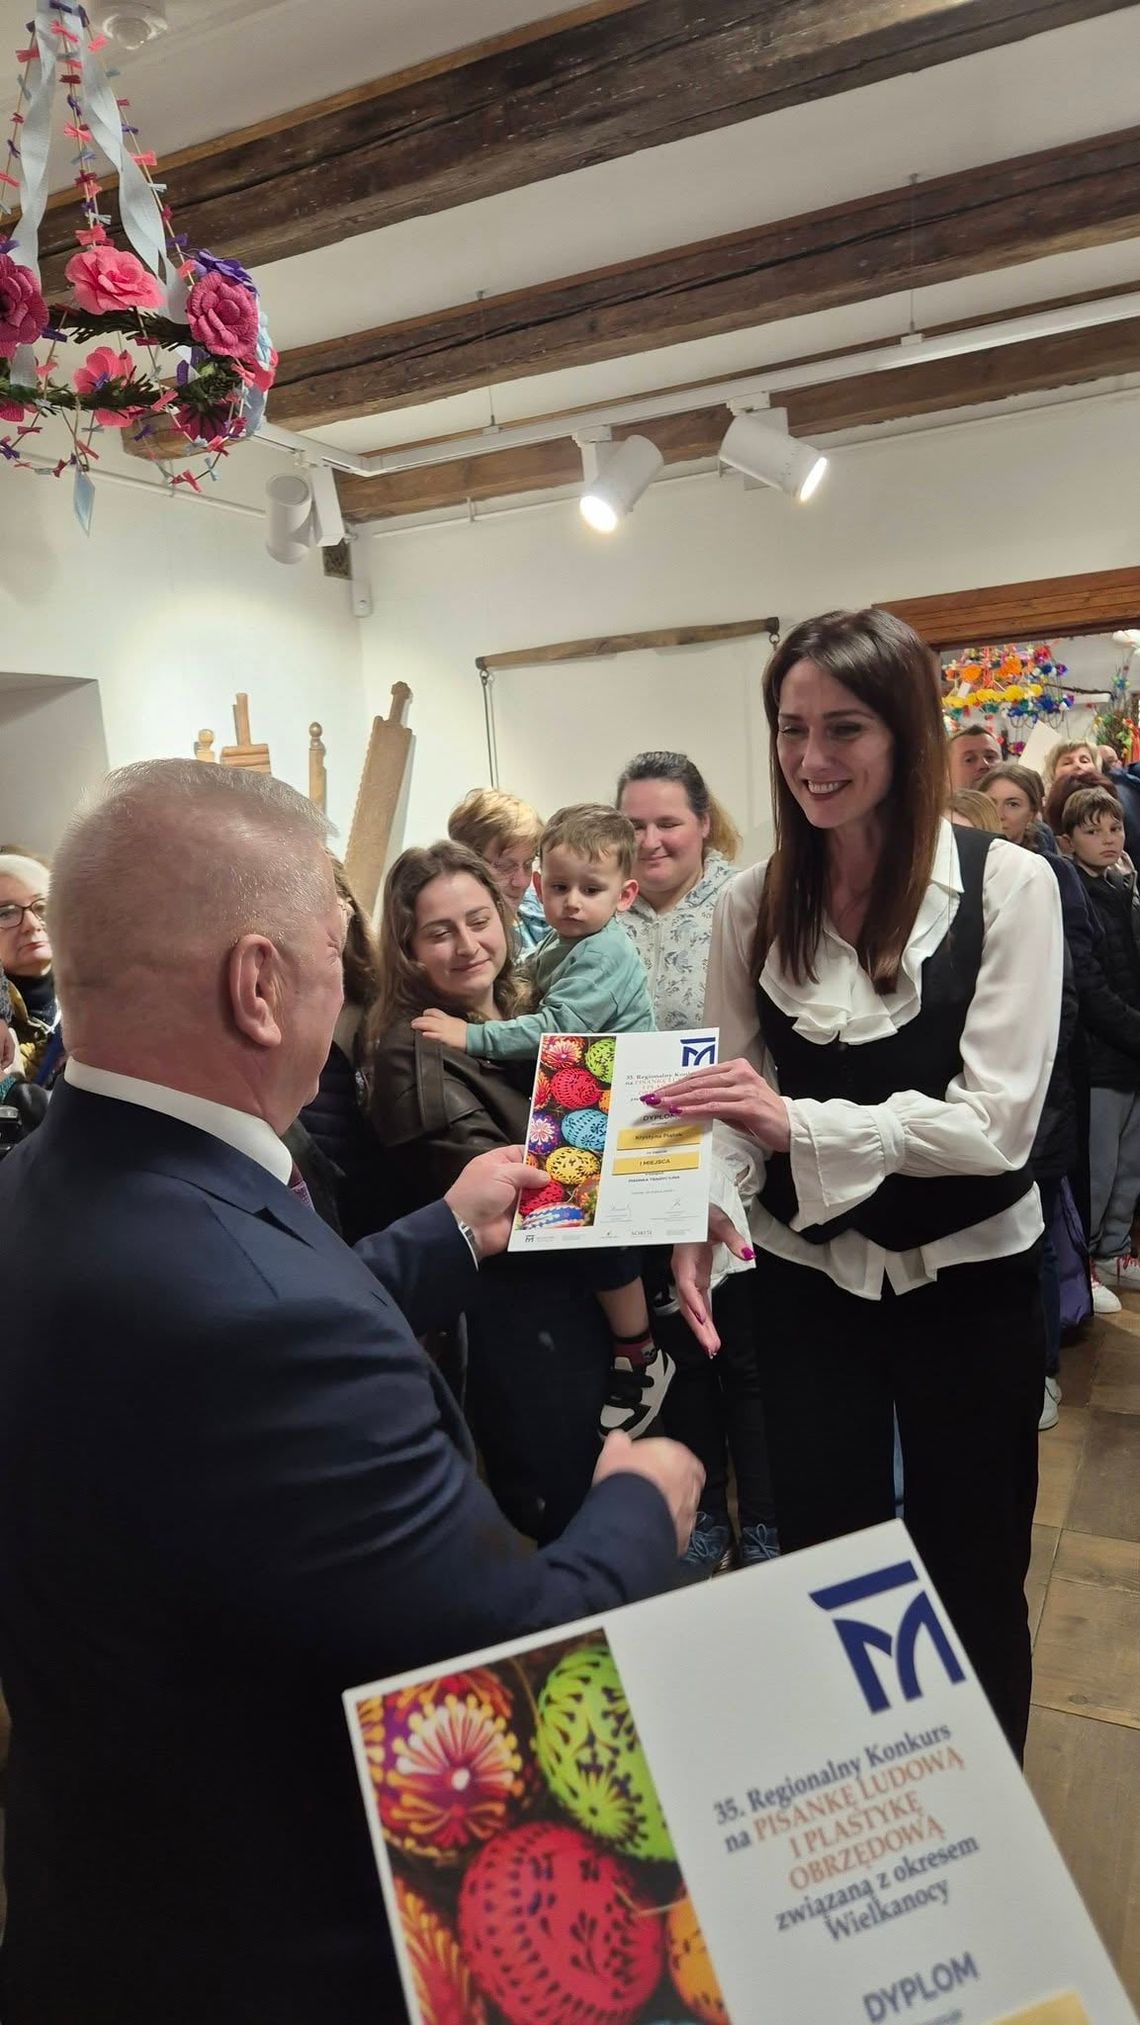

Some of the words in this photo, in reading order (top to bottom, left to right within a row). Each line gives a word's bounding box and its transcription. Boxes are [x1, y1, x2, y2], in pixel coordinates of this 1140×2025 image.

[643, 1158, 671, 1166] MIEJSCA
[713, 1796, 745, 1825] 35.
[746, 1757, 862, 1810] Regionalny
[864, 1723, 952, 1768] Konkurs
[724, 1830, 752, 1853] na
[753, 1784, 859, 1843] PISANKĘ
[857, 1746, 965, 1800] LUDOWĄ
[788, 1836, 802, 1859] I
[804, 1790, 925, 1852] PLASTYKĘ
[788, 1815, 947, 1890] OBRZĘDOWĄ
[775, 1879, 876, 1931] związaną
[876, 1872, 891, 1890] z
[893, 1836, 980, 1883] okresem
[824, 1879, 950, 1941] Wielkanocy
[862, 1950, 980, 2024] DYPLOM
